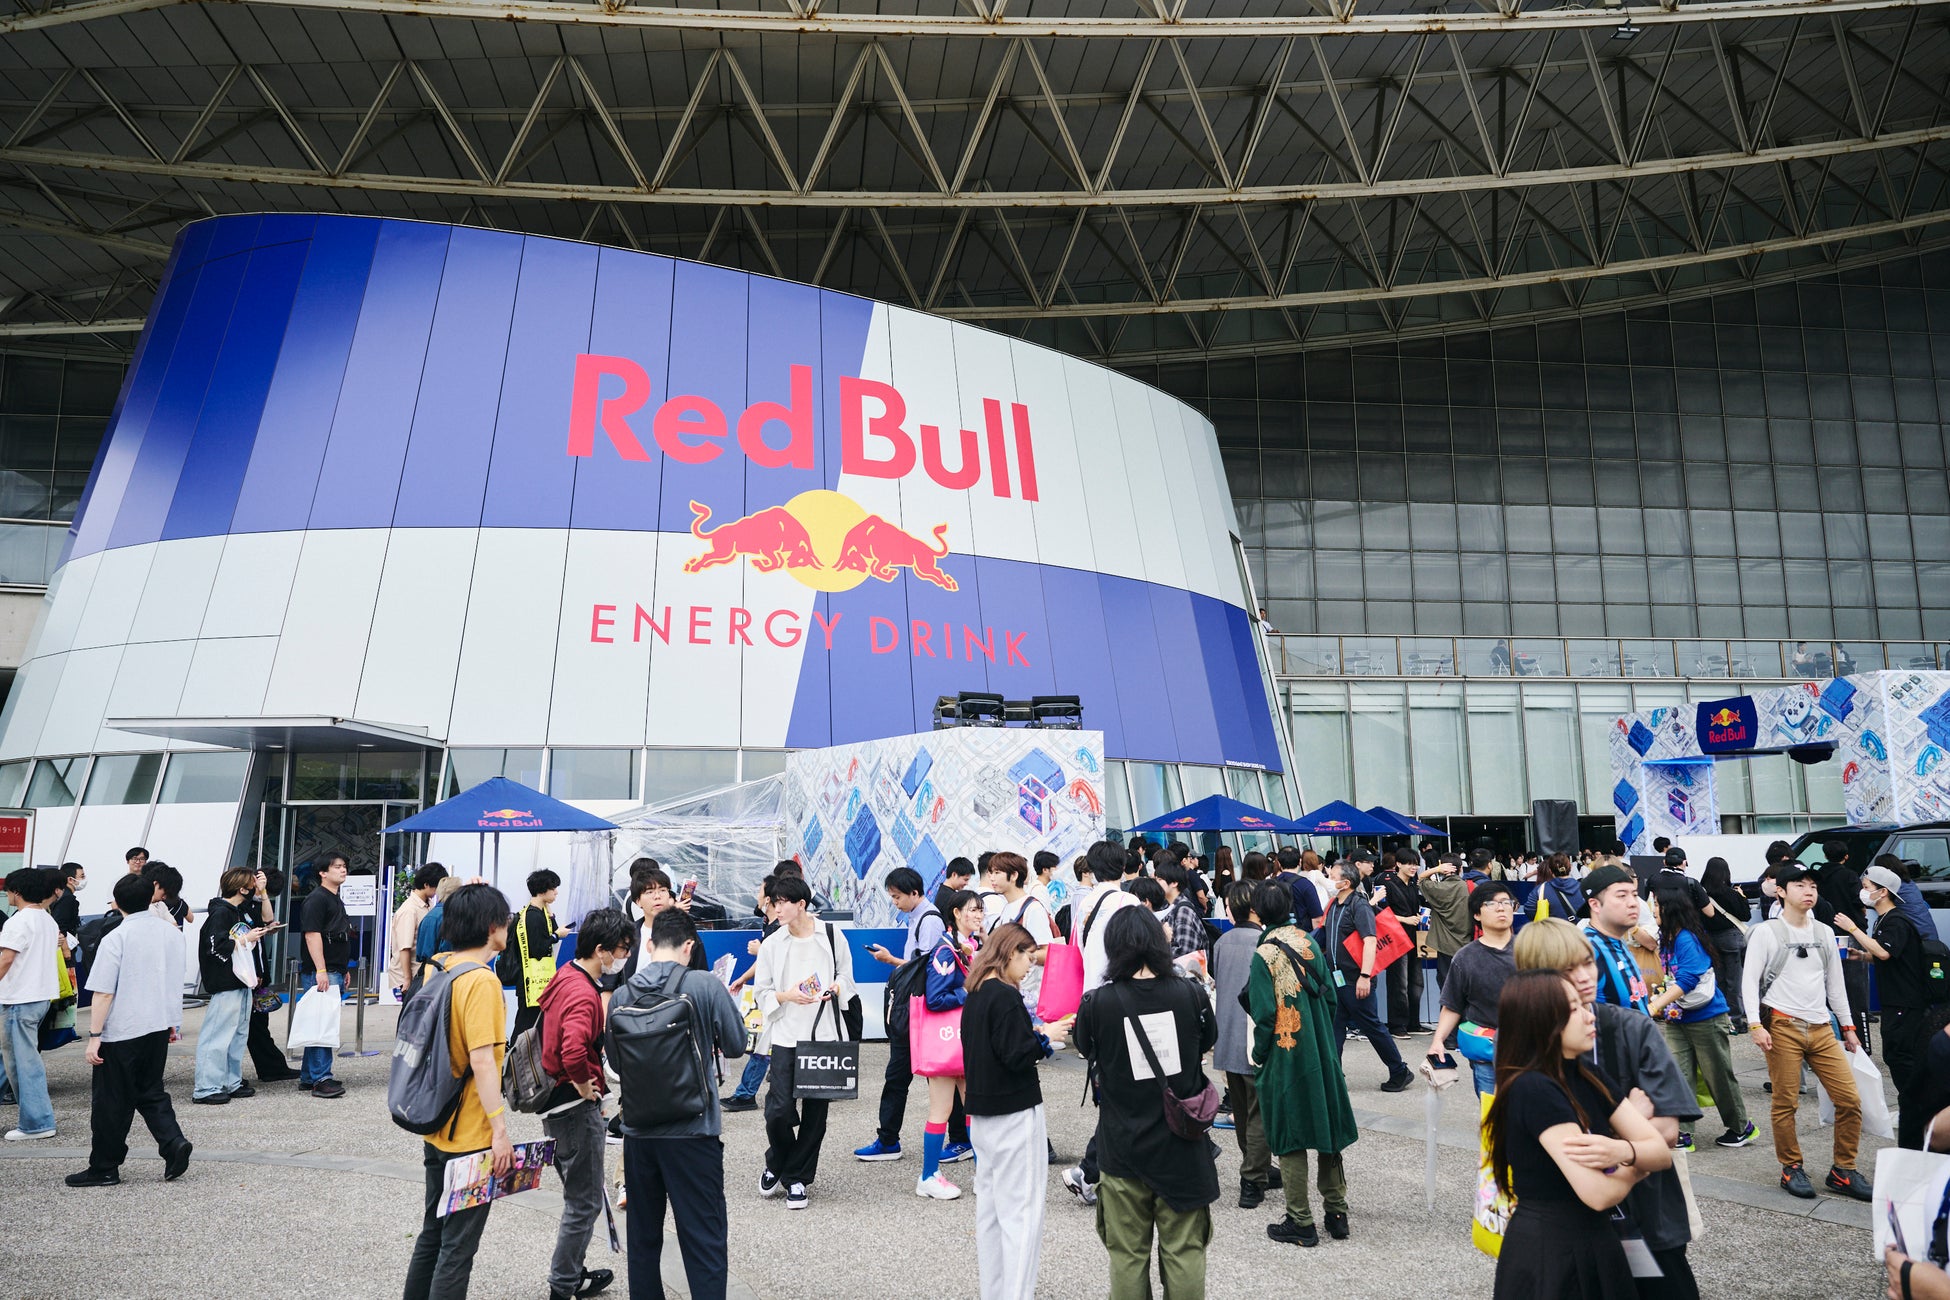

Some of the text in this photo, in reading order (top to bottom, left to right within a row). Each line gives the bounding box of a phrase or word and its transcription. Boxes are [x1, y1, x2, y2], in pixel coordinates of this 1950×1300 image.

[567, 353, 1039, 502] Red Bull
[591, 602, 1031, 667] ENERGY DRINK
[1708, 726, 1746, 743] Red Bull
[478, 819, 543, 827] Red Bull
[797, 1055, 856, 1071] TECH.C.
